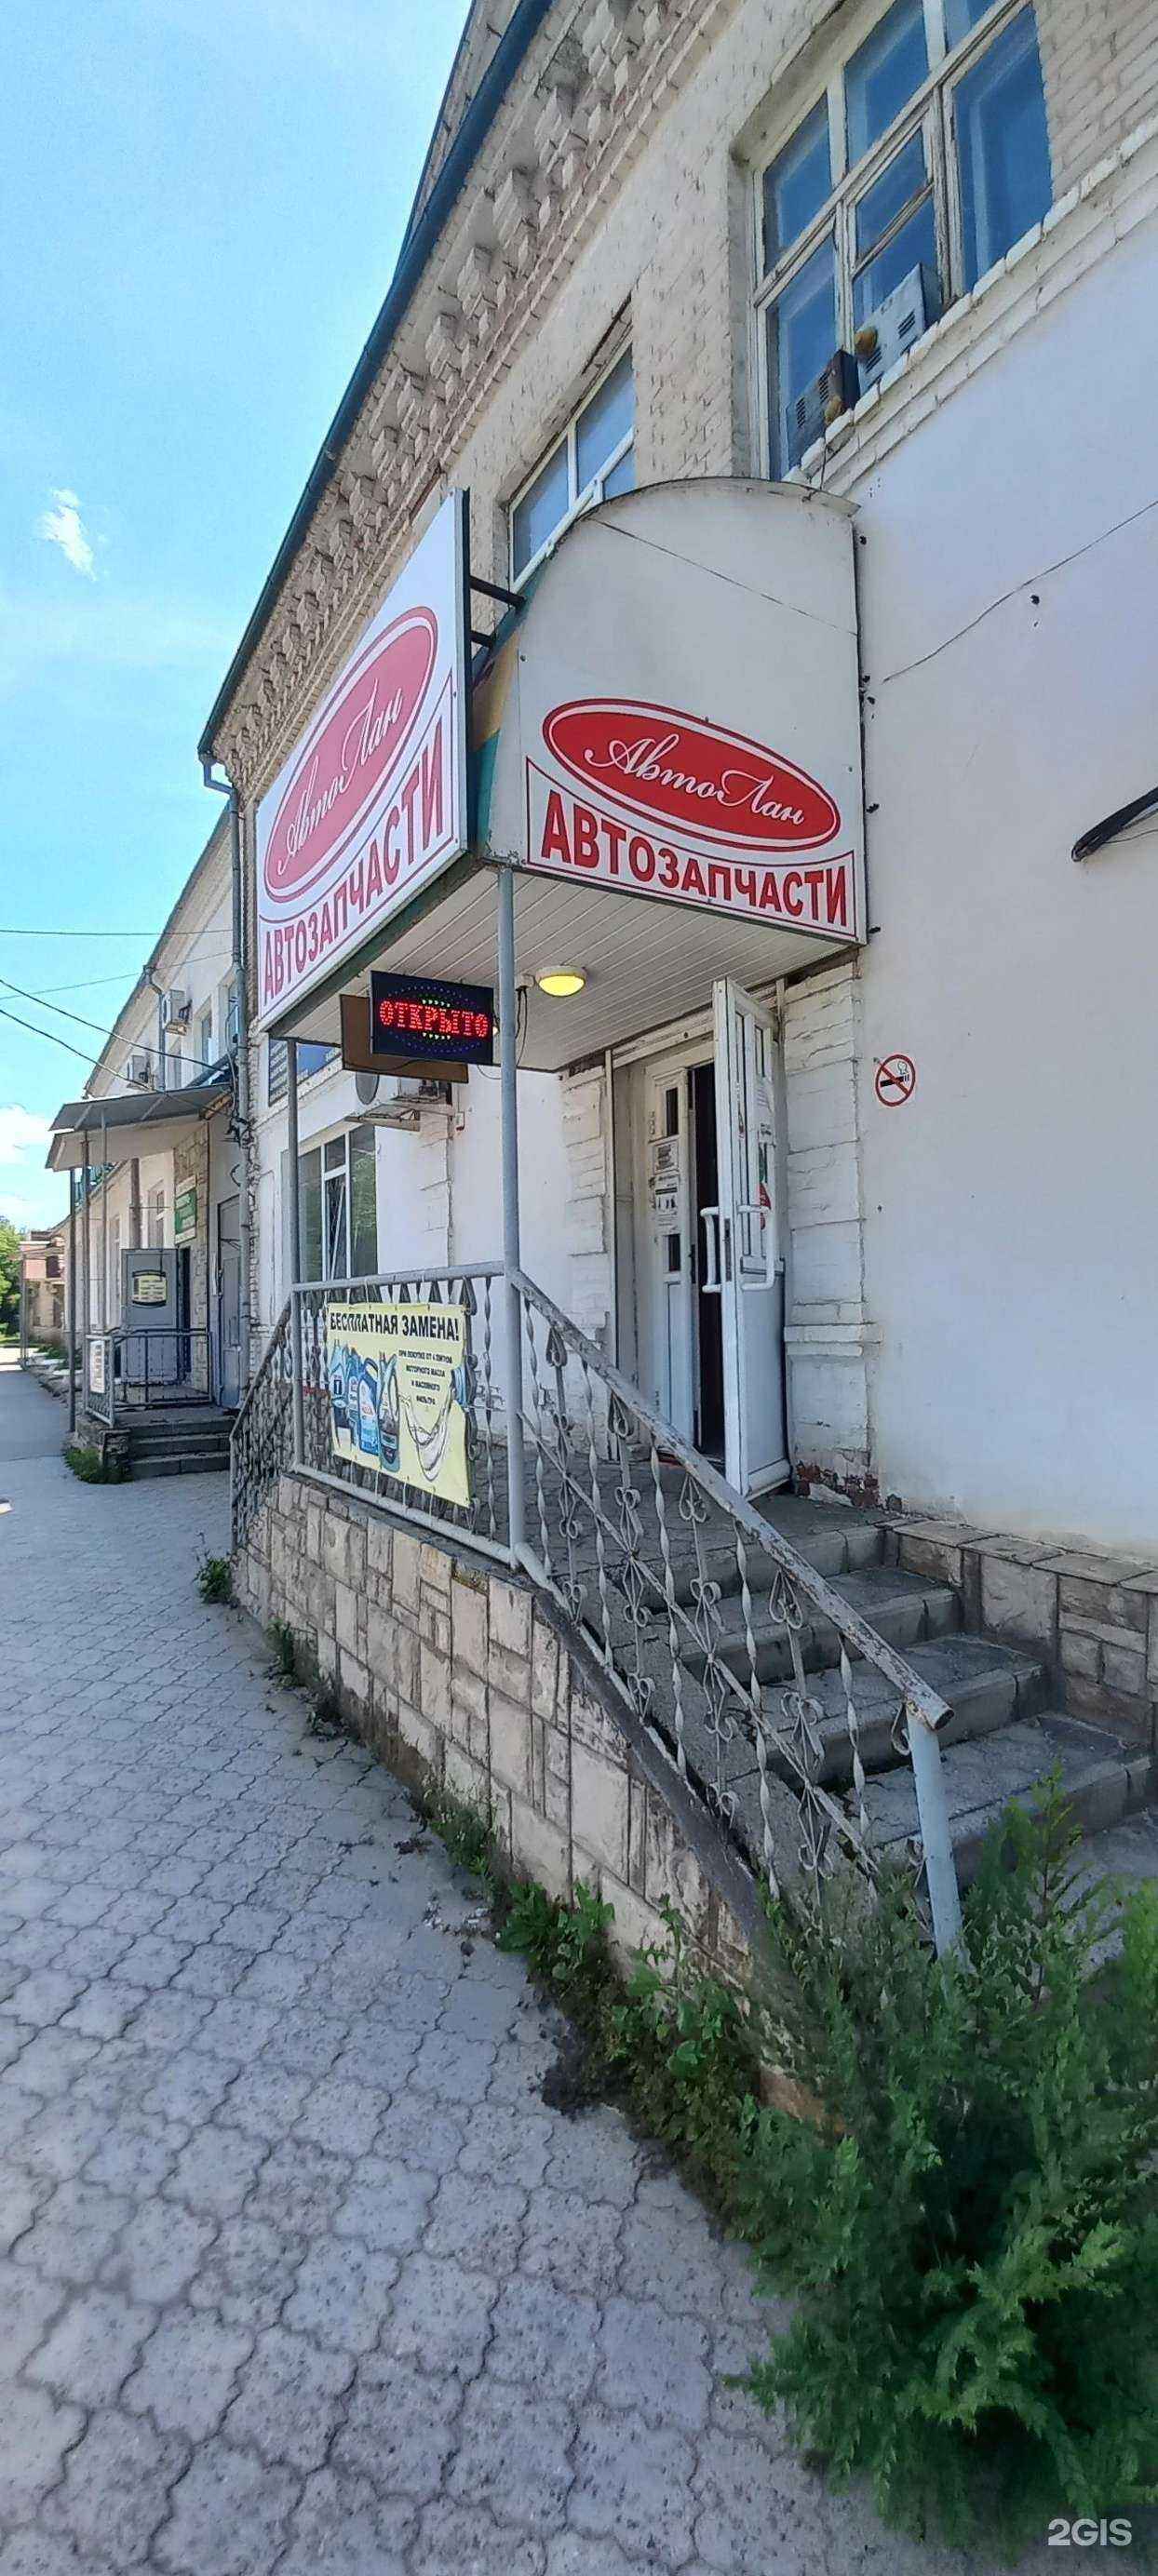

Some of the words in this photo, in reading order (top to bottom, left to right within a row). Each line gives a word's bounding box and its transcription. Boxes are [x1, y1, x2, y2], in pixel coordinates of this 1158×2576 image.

[584, 733, 804, 825] АвтоЛан
[263, 714, 444, 1007] АВТОЗАПЧАСТИ
[541, 789, 848, 927] АВТОЗАПЧАСТИ
[380, 1000, 489, 1038] ОТКРЫТО
[330, 1312, 398, 1335] БЕСПЛАТНАЯ
[401, 1314, 460, 1341] ЗАМЕНА!
